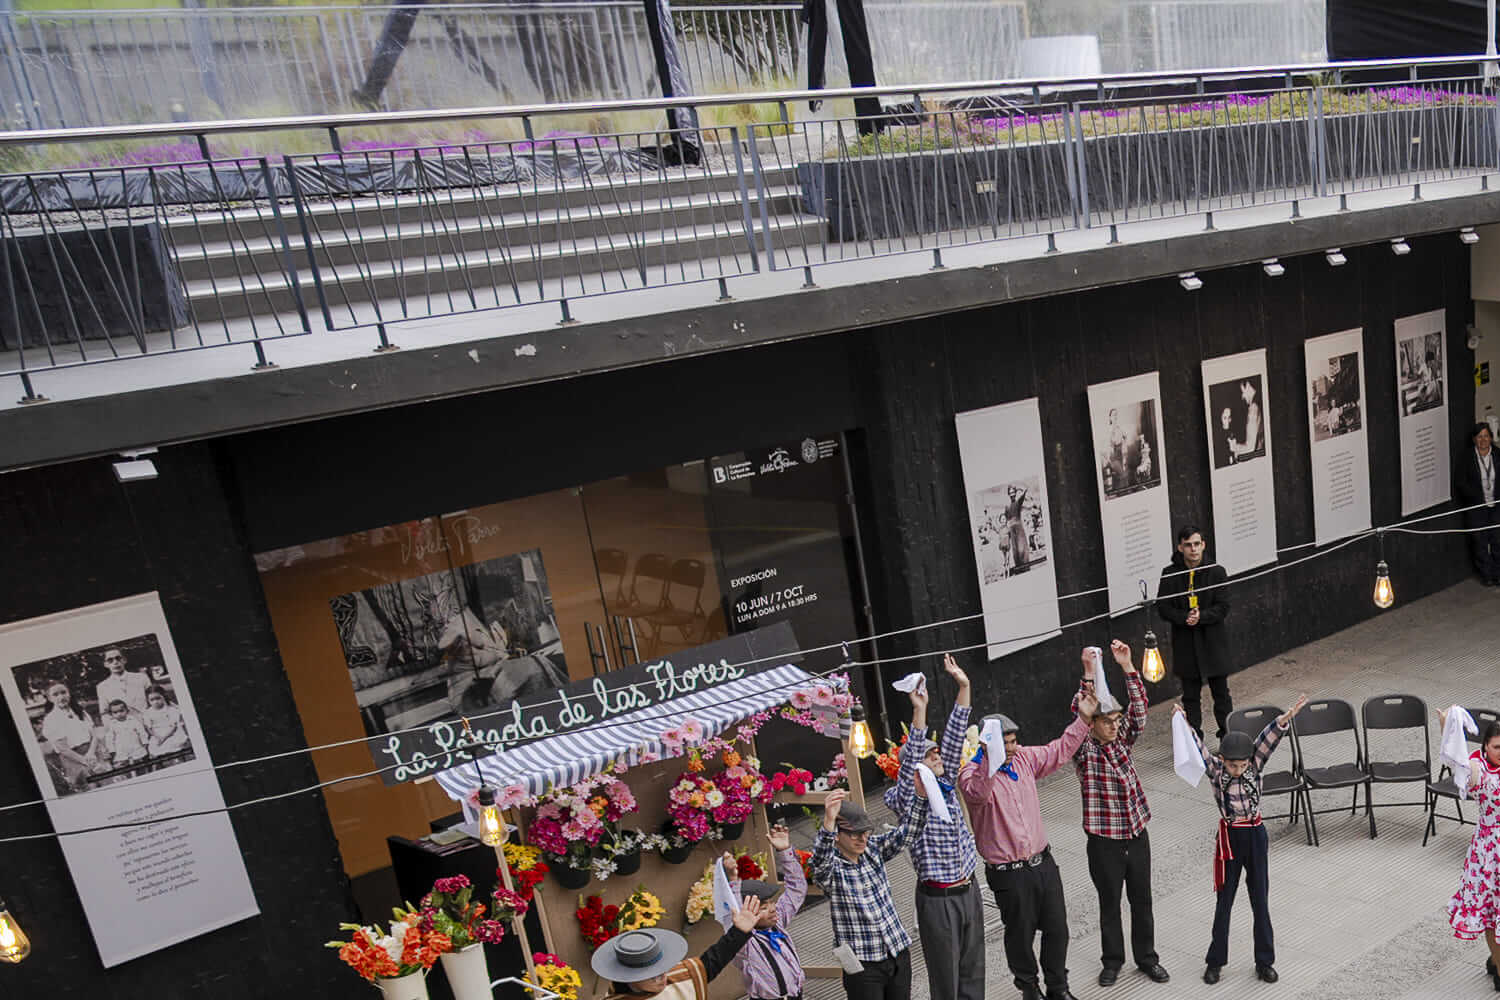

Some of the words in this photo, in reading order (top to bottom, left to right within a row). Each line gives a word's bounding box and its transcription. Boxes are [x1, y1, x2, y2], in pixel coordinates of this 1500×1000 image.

[730, 568, 777, 588] EXPOSICIÓN
[736, 602, 748, 614] 10
[749, 595, 769, 610] JUN
[776, 591, 782, 602] 7
[784, 585, 804, 599] OCT
[737, 612, 752, 623] LUN
[758, 606, 775, 616] DOM
[805, 593, 818, 603] HRS
[382, 735, 437, 782] La
[557, 689, 594, 729] de
[594, 677, 651, 716] las
[645, 659, 745, 702] Flores
